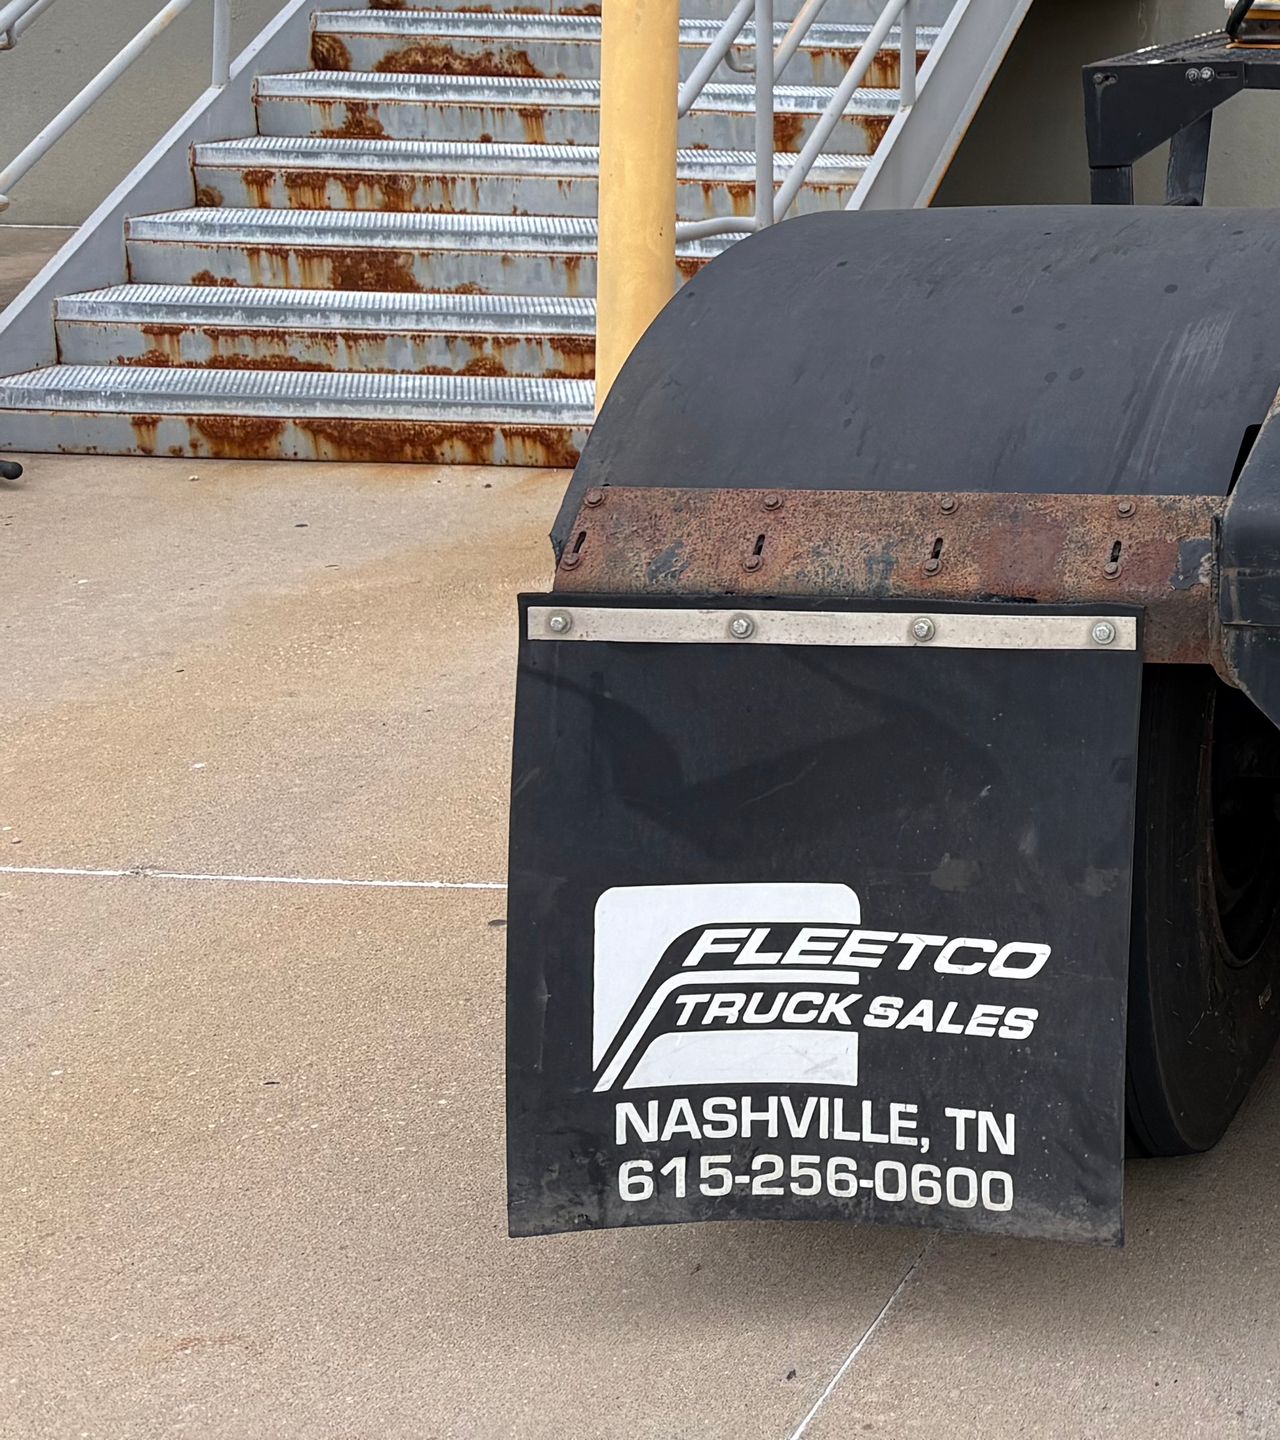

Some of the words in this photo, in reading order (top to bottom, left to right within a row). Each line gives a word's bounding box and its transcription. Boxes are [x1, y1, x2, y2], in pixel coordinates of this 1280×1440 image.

[682, 928, 1051, 979] FLEETCO
[676, 992, 862, 1025] TRUCK
[863, 996, 1038, 1039] SALES
[616, 1096, 930, 1153] NASHVILLE,
[945, 1108, 1015, 1155] TN
[619, 1154, 1013, 1211] 615-256-0600
